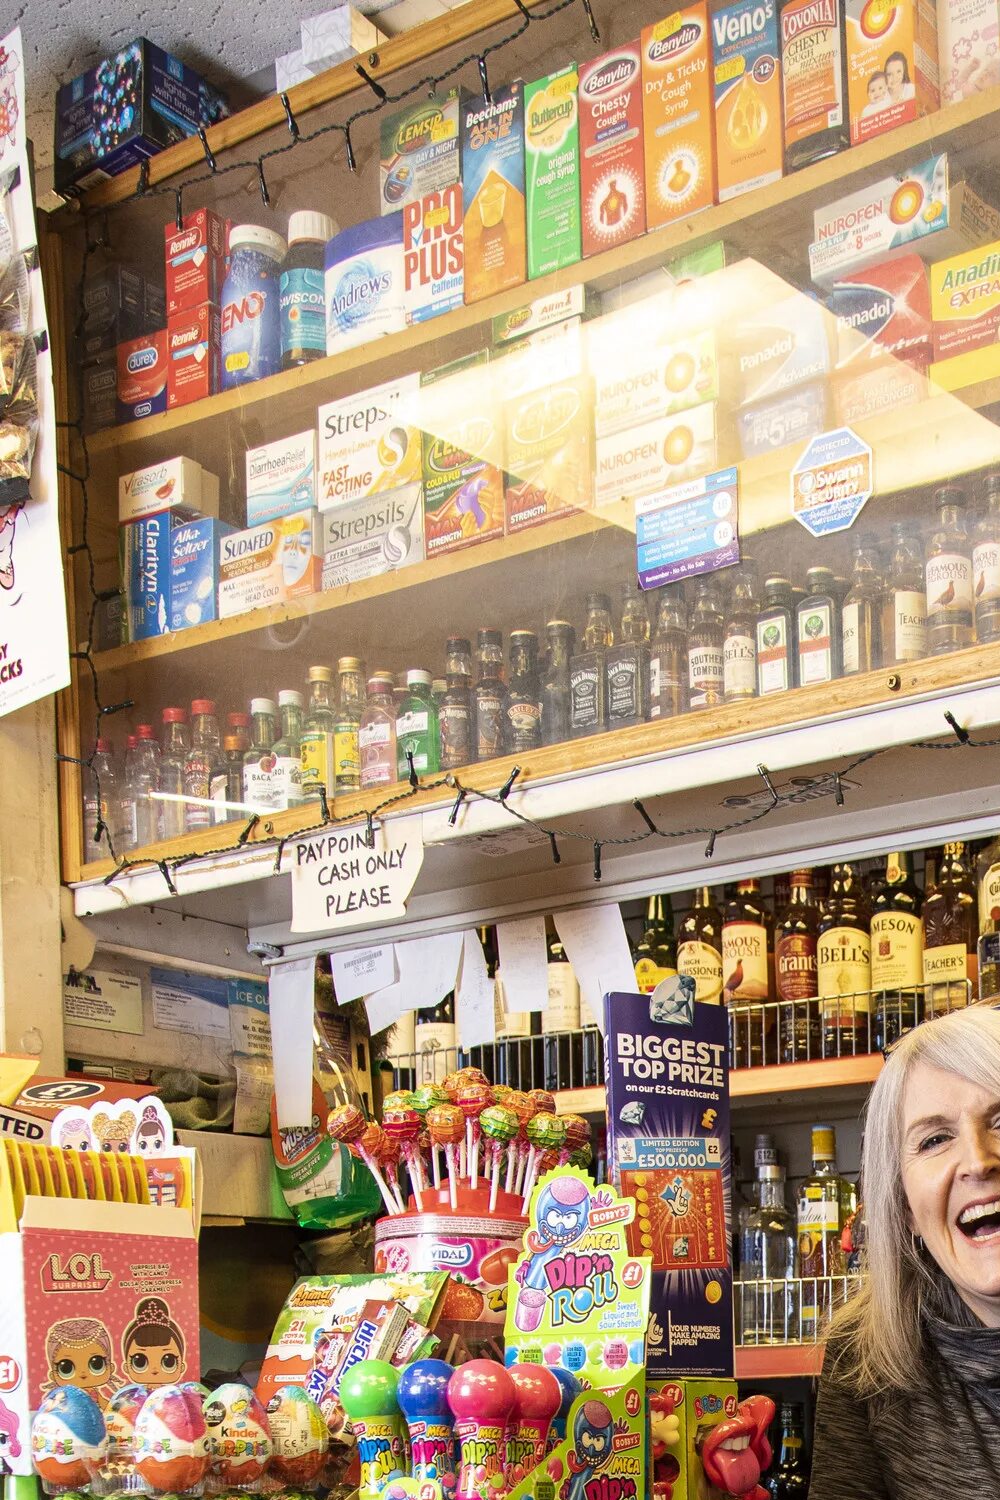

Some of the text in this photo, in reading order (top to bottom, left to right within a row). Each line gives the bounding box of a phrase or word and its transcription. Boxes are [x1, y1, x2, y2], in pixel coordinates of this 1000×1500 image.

[712, 2, 773, 44] Veno's
[782, 2, 834, 41] COVONIA
[652, 25, 700, 58] Benylin
[787, 29, 829, 55] CHESTY
[645, 58, 707, 95] Dry & Tickly
[661, 80, 692, 102] Cough
[466, 97, 518, 126] Beechams
[529, 100, 575, 128] Buttercup
[590, 94, 631, 118] Chesty
[664, 98, 689, 116] Syrup
[595, 111, 626, 130] Coughs
[547, 150, 575, 171] original
[818, 202, 883, 240] NUROFEN
[169, 230, 199, 257] Rennie
[405, 234, 463, 291] PLUS
[331, 270, 392, 316] Andrews
[431, 276, 463, 296] Caffeine
[950, 280, 1000, 307] EXTRA
[221, 291, 265, 336] ENO
[128, 349, 157, 369] durex
[740, 337, 793, 371] Panadol
[812, 437, 850, 454] PROTECTED
[600, 442, 657, 473] NUROFEN
[323, 465, 348, 486] FAST
[326, 471, 372, 500] ACTING
[815, 463, 863, 489] Swann
[803, 480, 859, 505] SECURITY
[328, 501, 405, 544] Strepsils
[173, 538, 209, 559] Seltzer
[174, 529, 201, 545] Alka-
[224, 531, 273, 561] SUDAFED
[428, 530, 462, 549] STRENGTH
[146, 519, 159, 591] Clarityn
[930, 562, 967, 572] FAMOUS
[930, 571, 968, 581] GROUSE
[318, 843, 407, 885] CASH ONLY
[326, 886, 392, 917] PLEASE
[682, 958, 701, 966] HIGH
[778, 955, 818, 973] Grant's
[820, 945, 870, 965] BELL'S
[924, 956, 964, 971] TEACHER'S
[617, 1034, 724, 1066] BIGGEST
[617, 1058, 724, 1087] TOP PRIZE
[625, 1084, 719, 1100] on our £2 Scratchcards
[641, 1139, 700, 1147] LIMITED EDITION
[638, 1153, 705, 1168] £500,000
[592, 1205, 630, 1224] BOBBY'S
[579, 1233, 619, 1251] MEGA
[51, 1254, 111, 1280] LOL
[550, 1265, 640, 1327] Roll £1
[617, 1302, 636, 1310] Sweet
[599, 1317, 641, 1328] Sour Sherbet
[604, 1311, 624, 1320] Liquid
[670, 1324, 721, 1334] YOUR NUMBERS
[670, 1332, 720, 1341] MAKE AMAZING
[670, 1338, 698, 1346] HAPPEN
